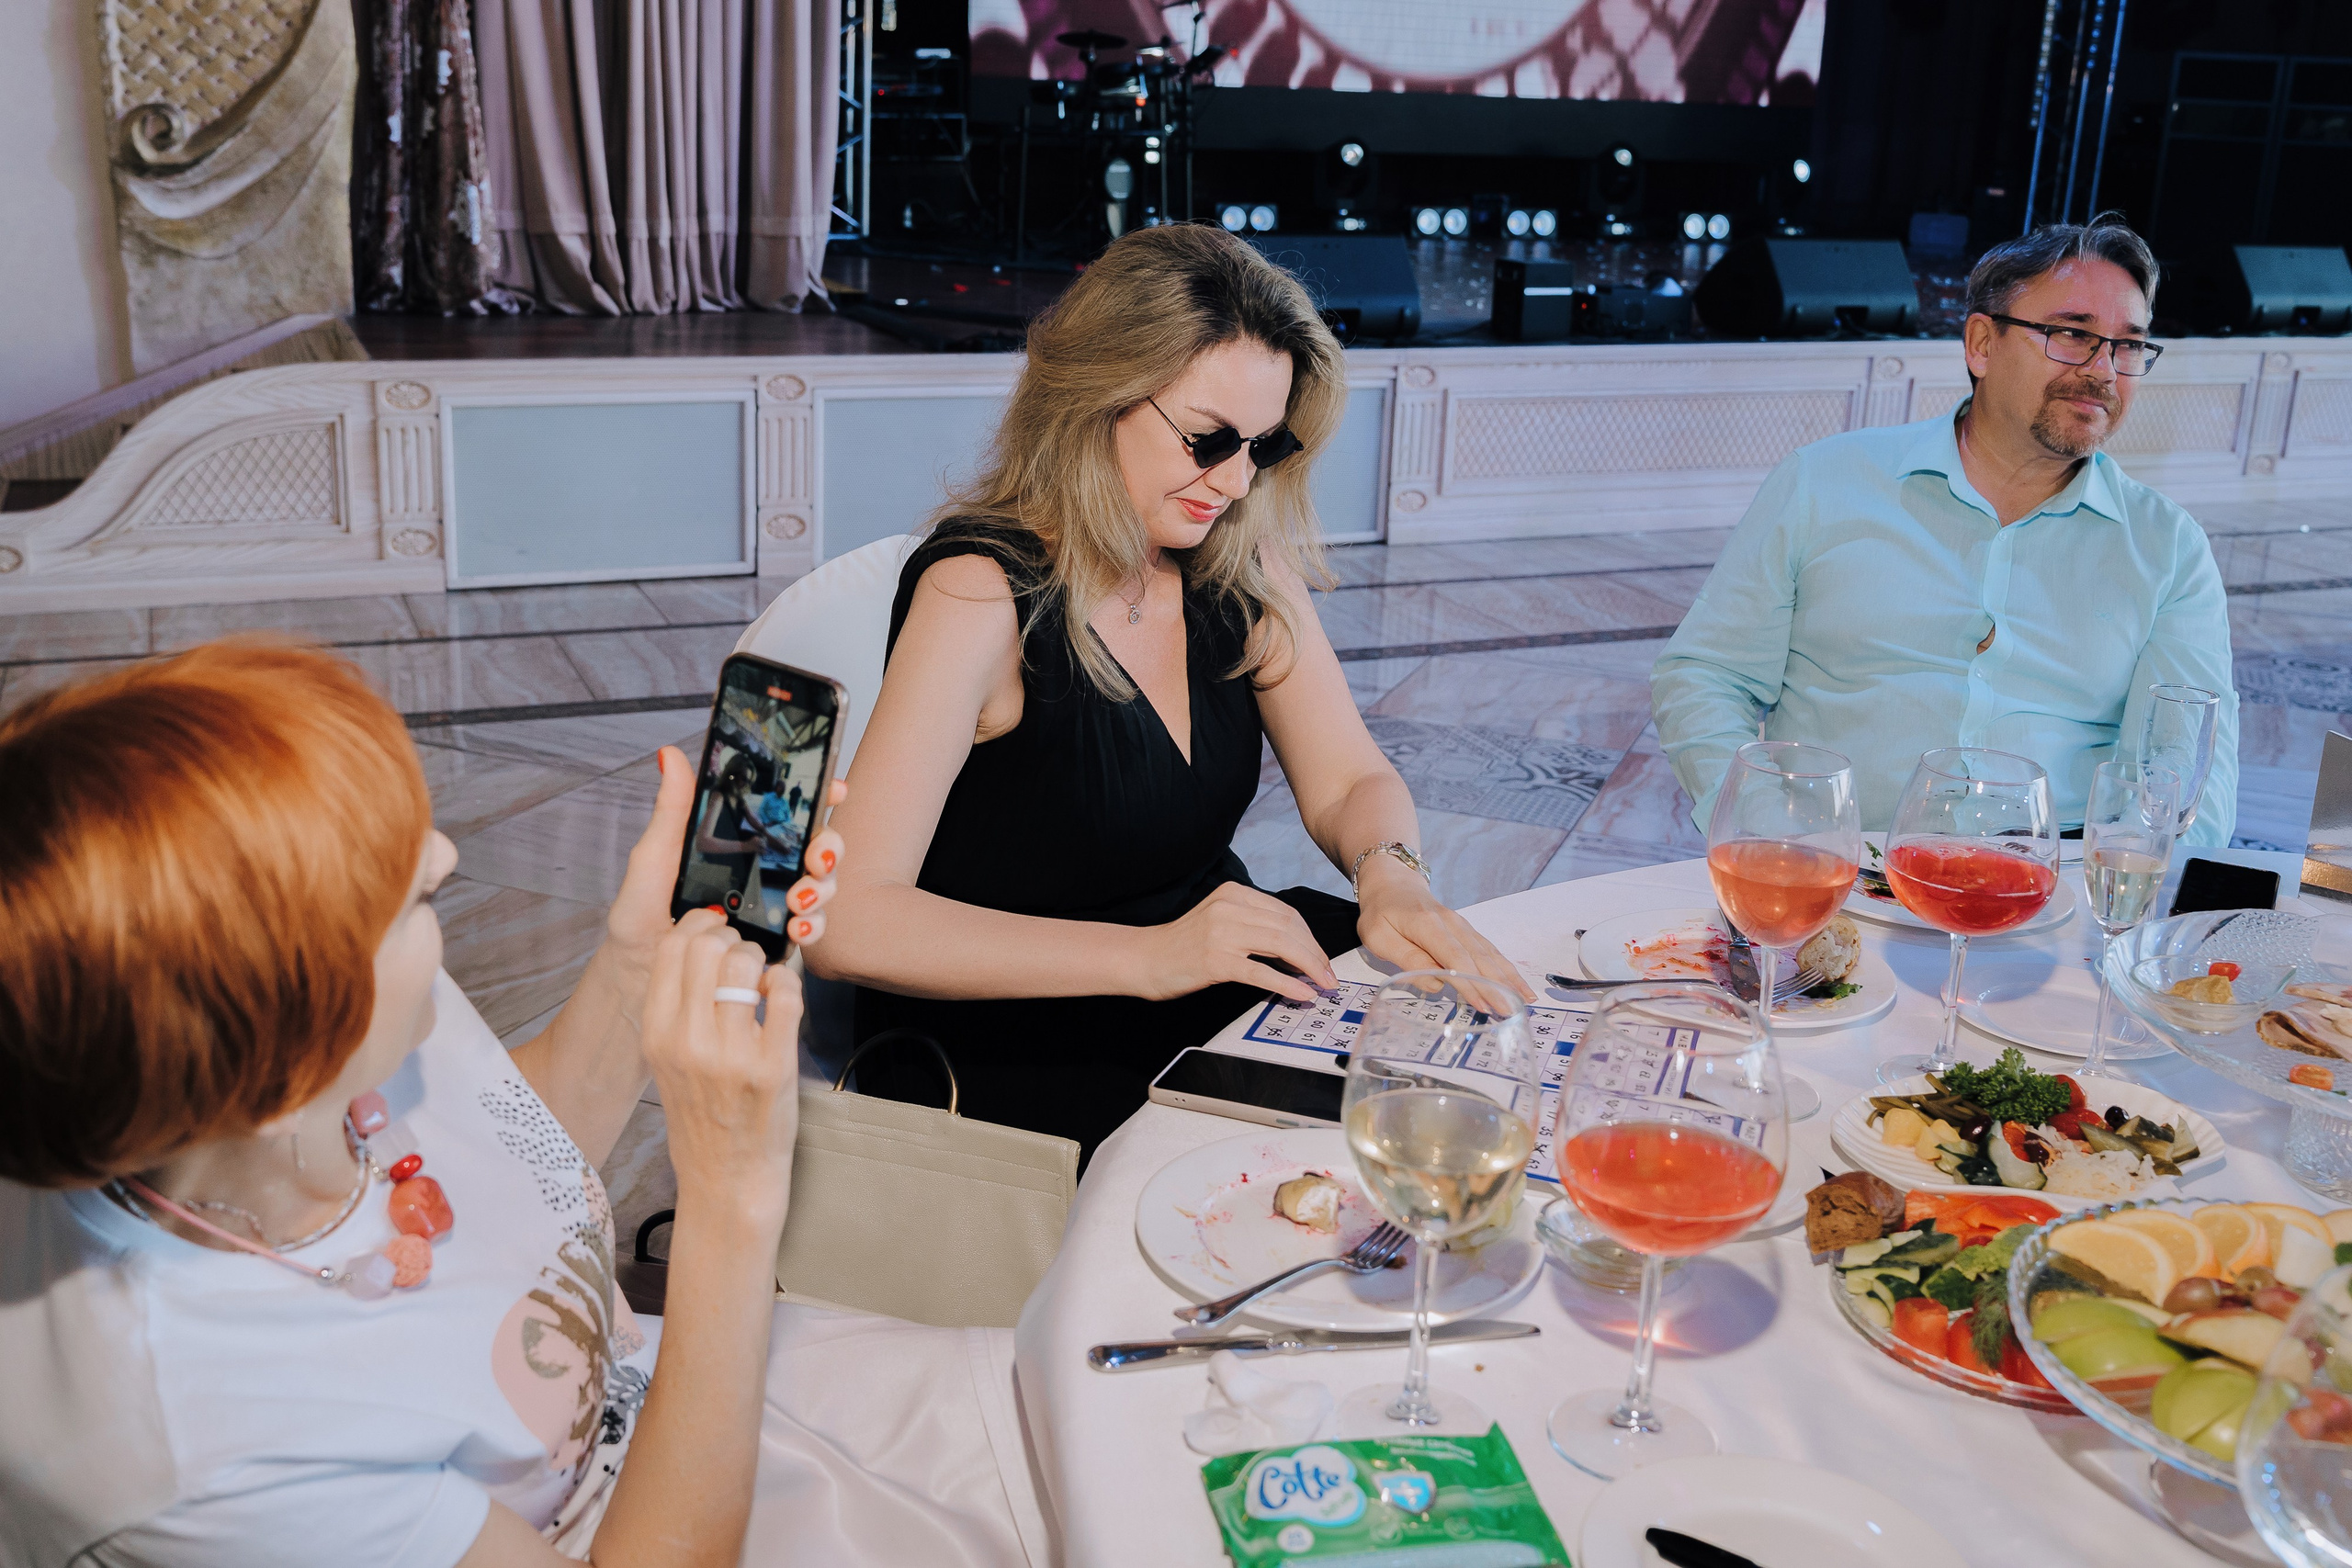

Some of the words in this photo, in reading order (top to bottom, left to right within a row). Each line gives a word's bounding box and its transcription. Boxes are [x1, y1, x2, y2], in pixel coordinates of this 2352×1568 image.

[1278, 1015, 1292, 1023] 47
[1310, 1020, 1326, 1029] 60
[1343, 1025, 1358, 1034] 55
[1301, 1033, 1317, 1042] 61
[1569, 1031, 1584, 1040] 16
[1539, 1125, 1553, 1136] 35
